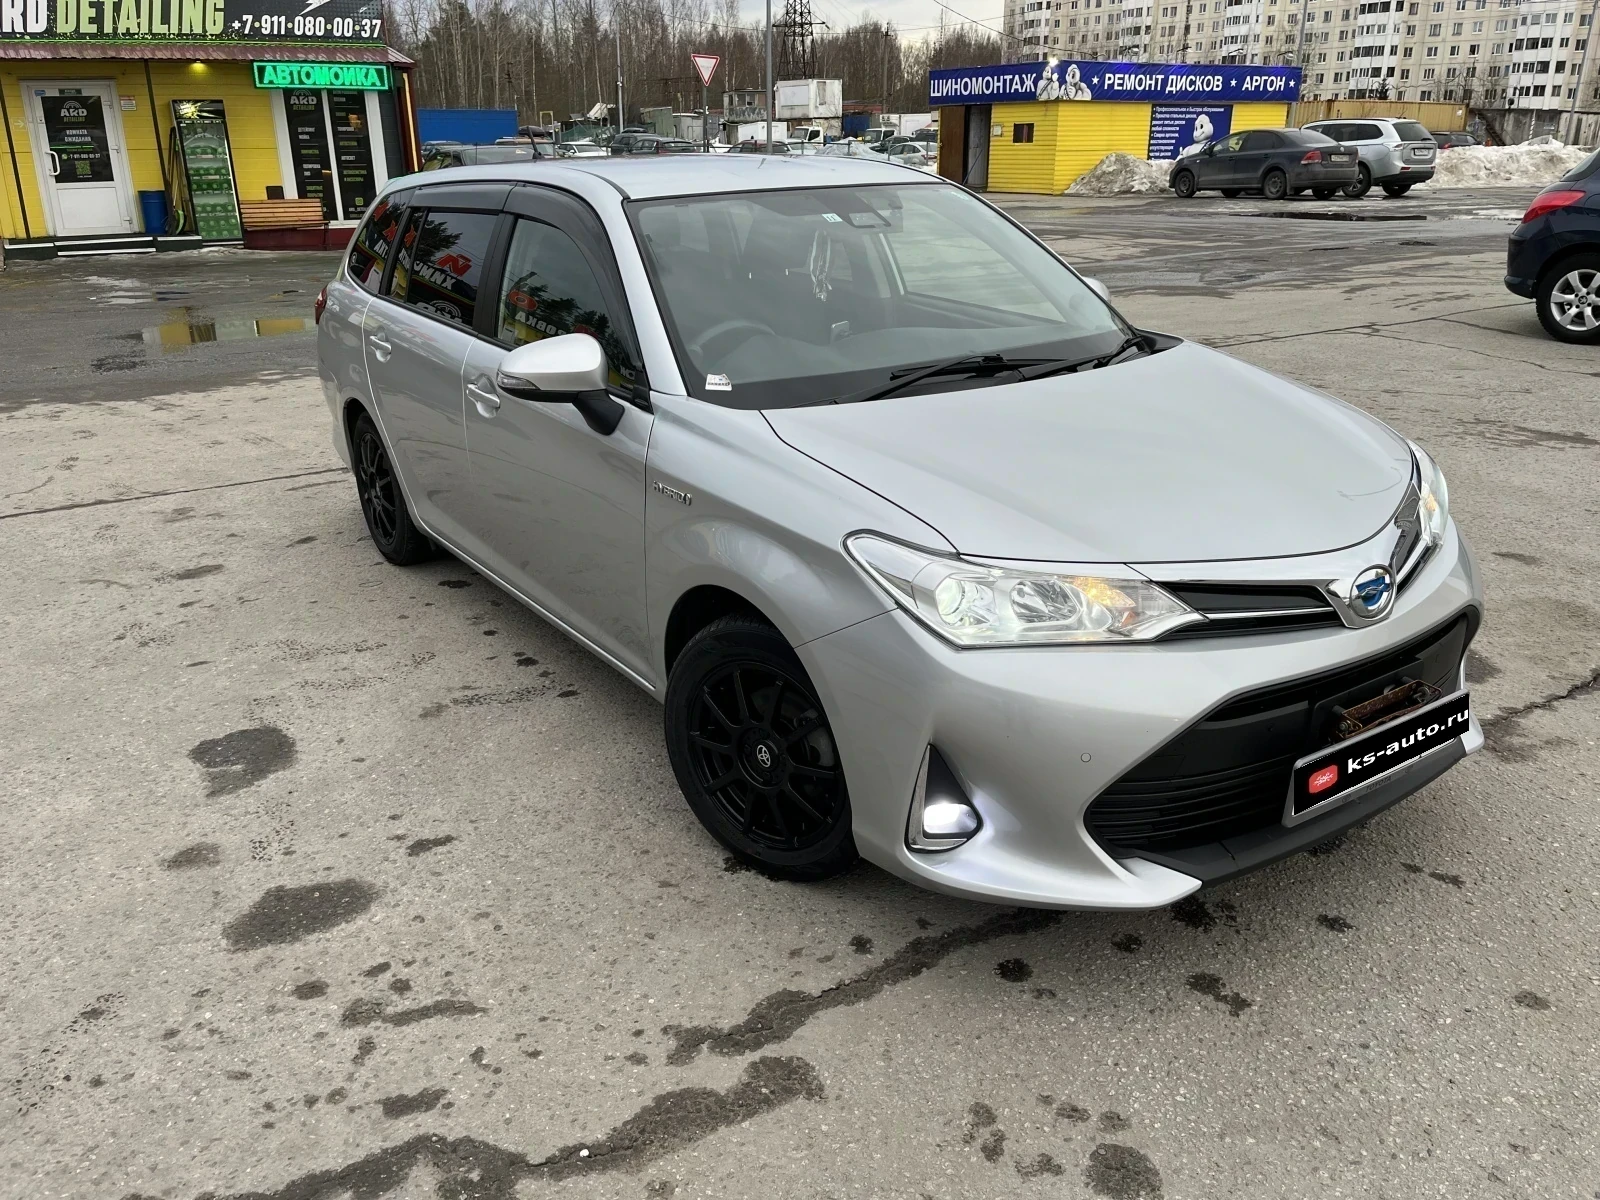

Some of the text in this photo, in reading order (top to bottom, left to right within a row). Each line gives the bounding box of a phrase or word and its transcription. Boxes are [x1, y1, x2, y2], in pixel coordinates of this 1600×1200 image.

[0, 0, 225, 36] RD DETAILING
[930, 73, 1036, 97] ШИНОМОНТАЖ
[1104, 73, 1286, 93] РЕМОНТ ДИСКОВ АРГОН
